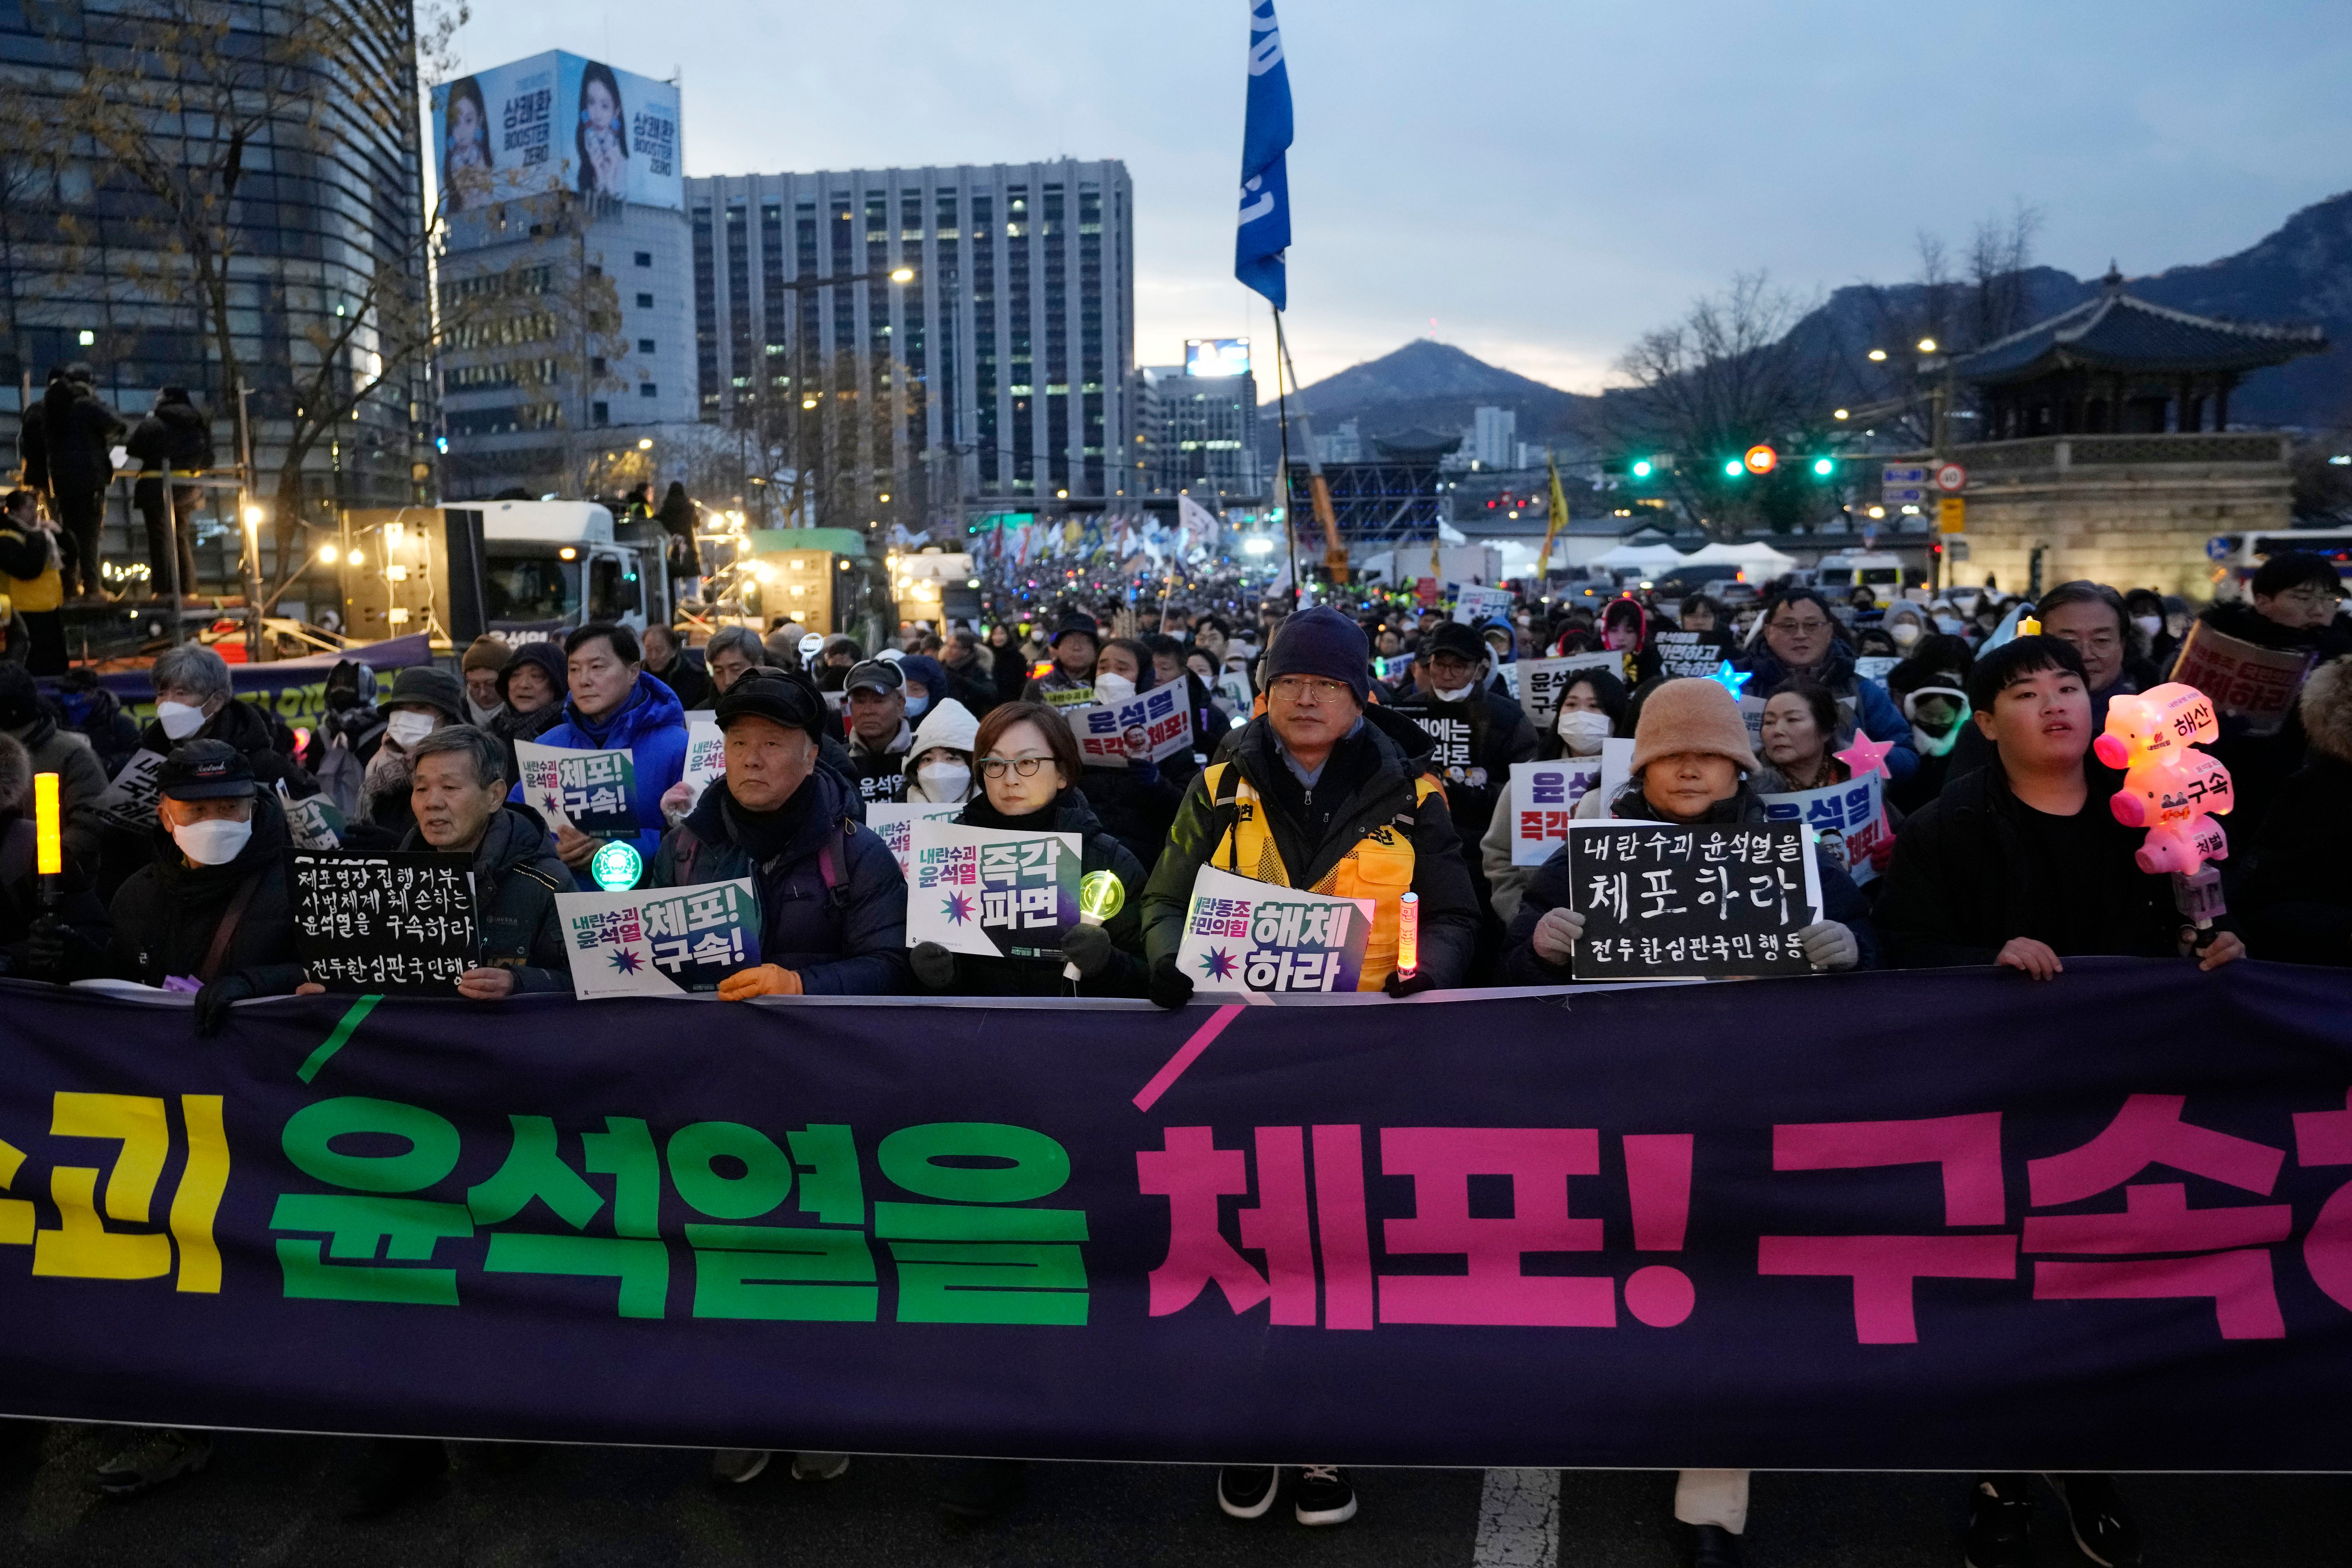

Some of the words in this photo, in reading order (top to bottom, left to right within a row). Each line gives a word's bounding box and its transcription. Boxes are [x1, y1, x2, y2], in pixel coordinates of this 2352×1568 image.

[523, 144, 549, 167] ZERO
[1087, 689, 1173, 734] 윤석열
[2174, 703, 2212, 736] 해산
[693, 739, 723, 754] 내란수
[1082, 736, 1126, 757] 즉각
[523, 760, 557, 772] 내란수괴
[526, 773, 558, 788] 윤석열
[560, 754, 623, 788] 체포!
[564, 785, 627, 820] 구속!
[1533, 772, 1595, 803] 윤석
[2188, 772, 2228, 804] 구속
[1237, 803, 1254, 823] 변
[1521, 811, 1568, 841] 즉각
[920, 845, 976, 864] 내란수괴
[982, 840, 1061, 886] 즉각
[1700, 831, 1800, 864] 윤석열을
[298, 868, 370, 890] 체포영장
[918, 863, 976, 888] 윤석열
[302, 888, 380, 915] 사법체계
[983, 885, 1057, 930] 파면
[1588, 865, 1797, 926] 체포하라
[572, 907, 639, 930] 내란수괴
[645, 886, 739, 938] 체포!
[1255, 905, 1352, 948] 해체
[302, 912, 370, 939] 윤석열을
[386, 915, 475, 947] 구속하라
[576, 922, 642, 950] 윤석열
[654, 926, 745, 973] 구속!
[1247, 950, 1340, 992] 하라
[0, 1090, 224, 1295] 괴
[269, 1095, 1091, 1327] 윤석열을
[1135, 1123, 1696, 1330] 체포!
[1757, 1093, 2352, 1344] 구속
